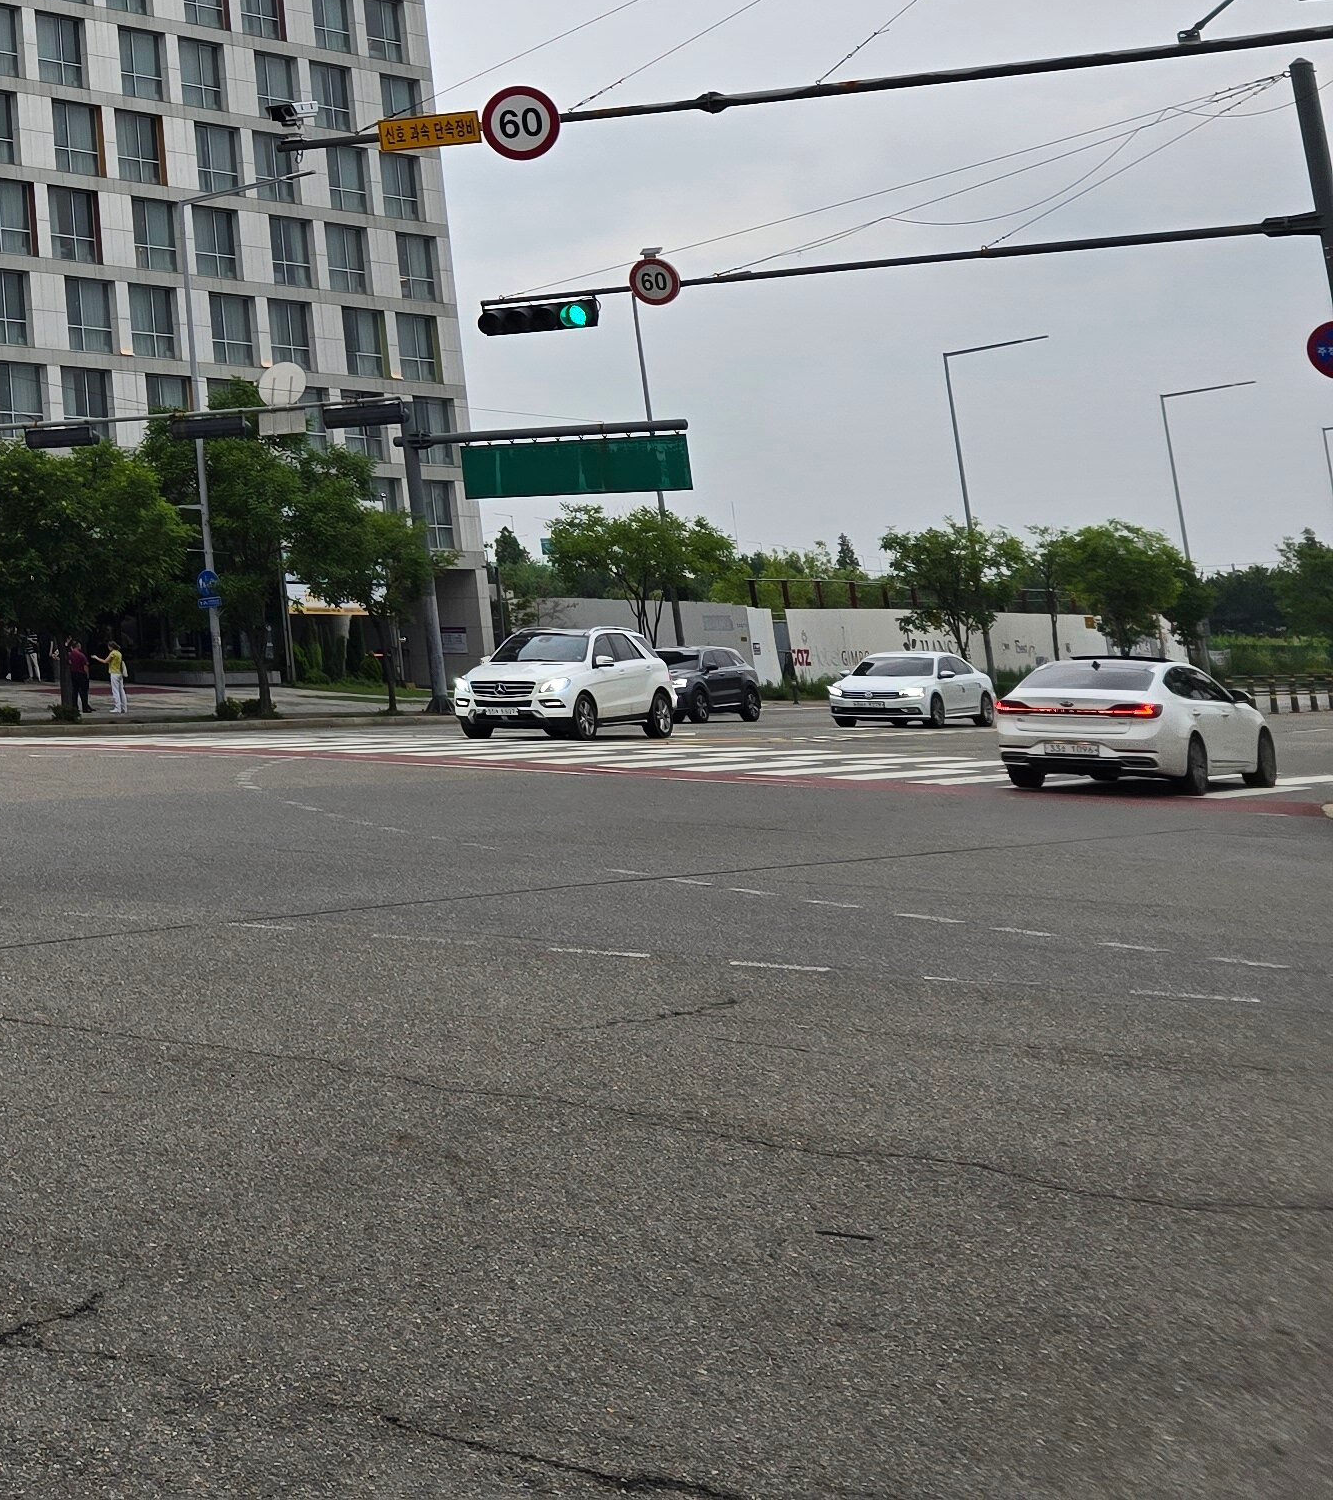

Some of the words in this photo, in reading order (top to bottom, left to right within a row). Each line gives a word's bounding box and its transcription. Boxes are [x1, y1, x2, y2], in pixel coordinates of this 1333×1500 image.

[385, 125, 406, 144] 신호
[410, 123, 431, 142] 과속
[434, 118, 476, 140] 단속장비
[499, 107, 543, 139] 60
[641, 271, 668, 291] 60
